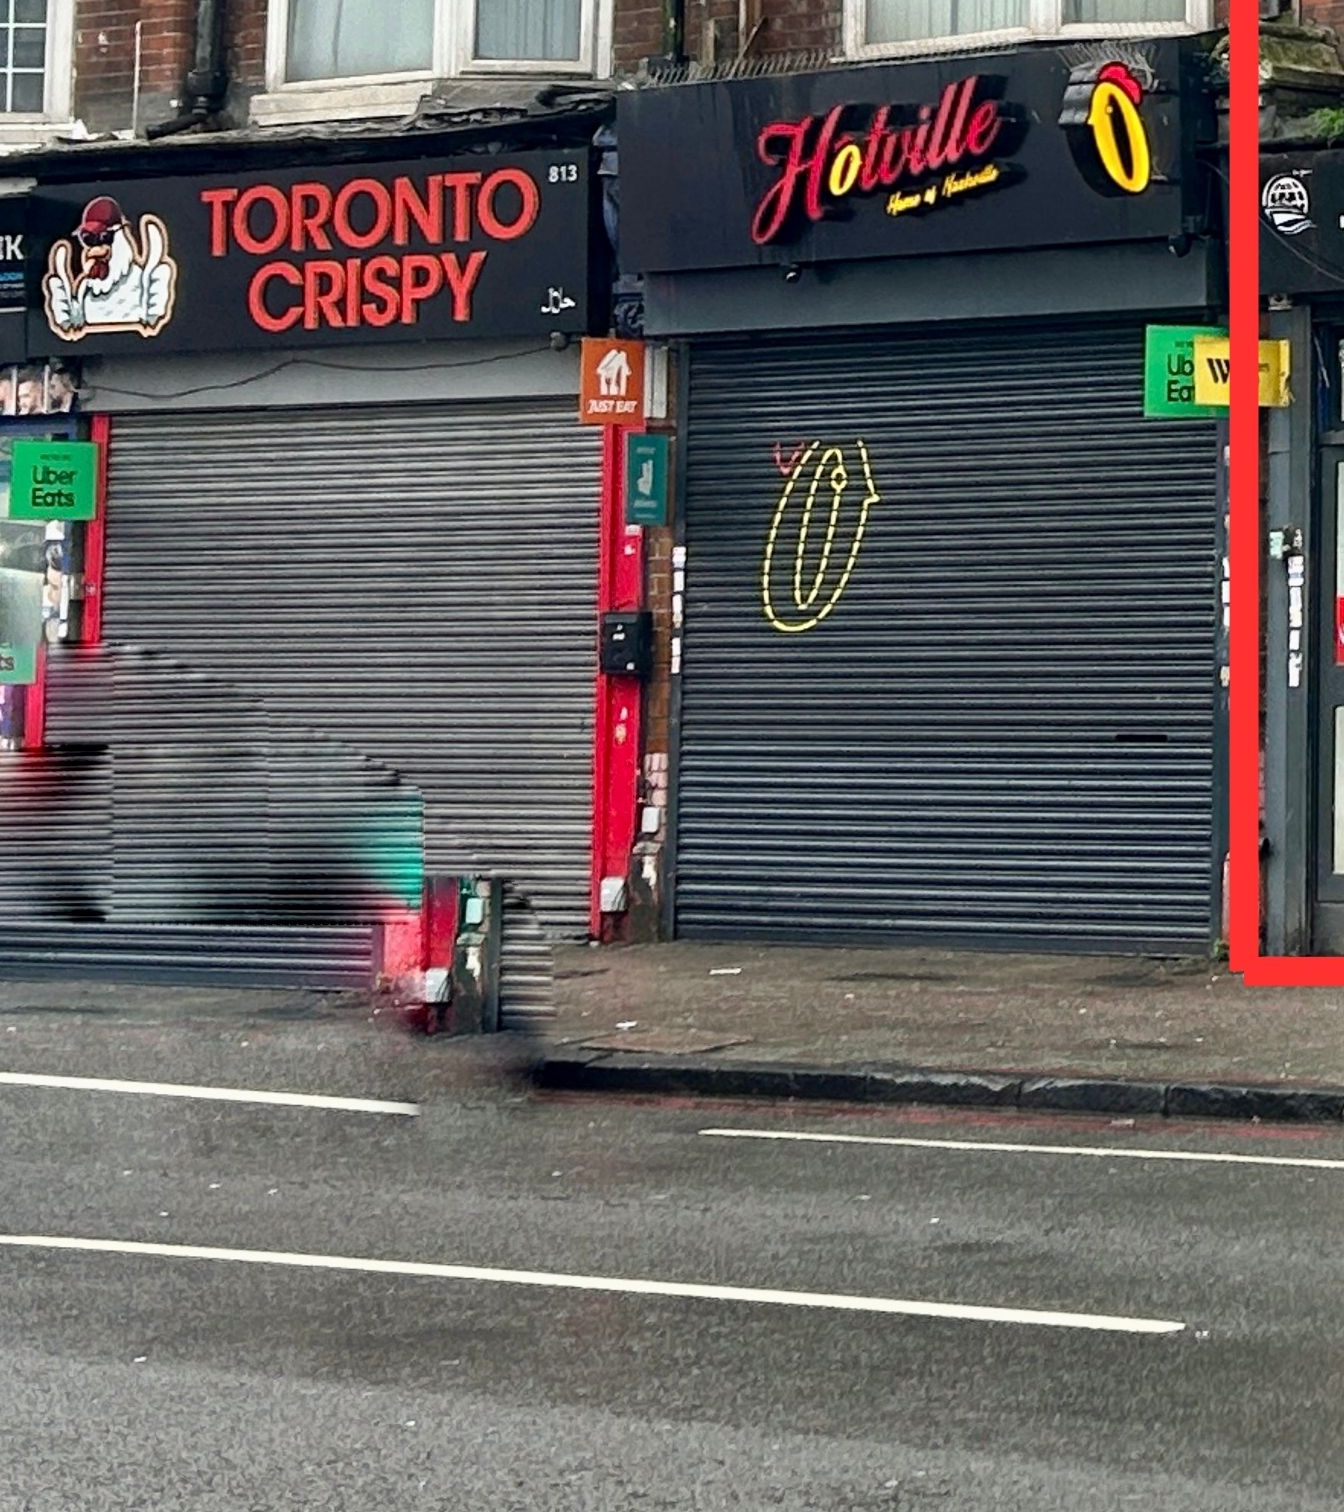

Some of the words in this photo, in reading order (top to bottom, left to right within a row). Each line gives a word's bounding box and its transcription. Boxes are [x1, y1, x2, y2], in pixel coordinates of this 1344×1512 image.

[750, 75, 1002, 245] Hotville
[548, 164, 579, 183] 813
[201, 167, 542, 257] TORONTO
[248, 251, 487, 332] CRISPY
[1167, 353, 1194, 376] Ub
[1166, 379, 1195, 402] Ea
[587, 400, 615, 414] JUST
[616, 400, 638, 413] EAT
[32, 465, 77, 485] Uber
[31, 487, 75, 507] Eats
